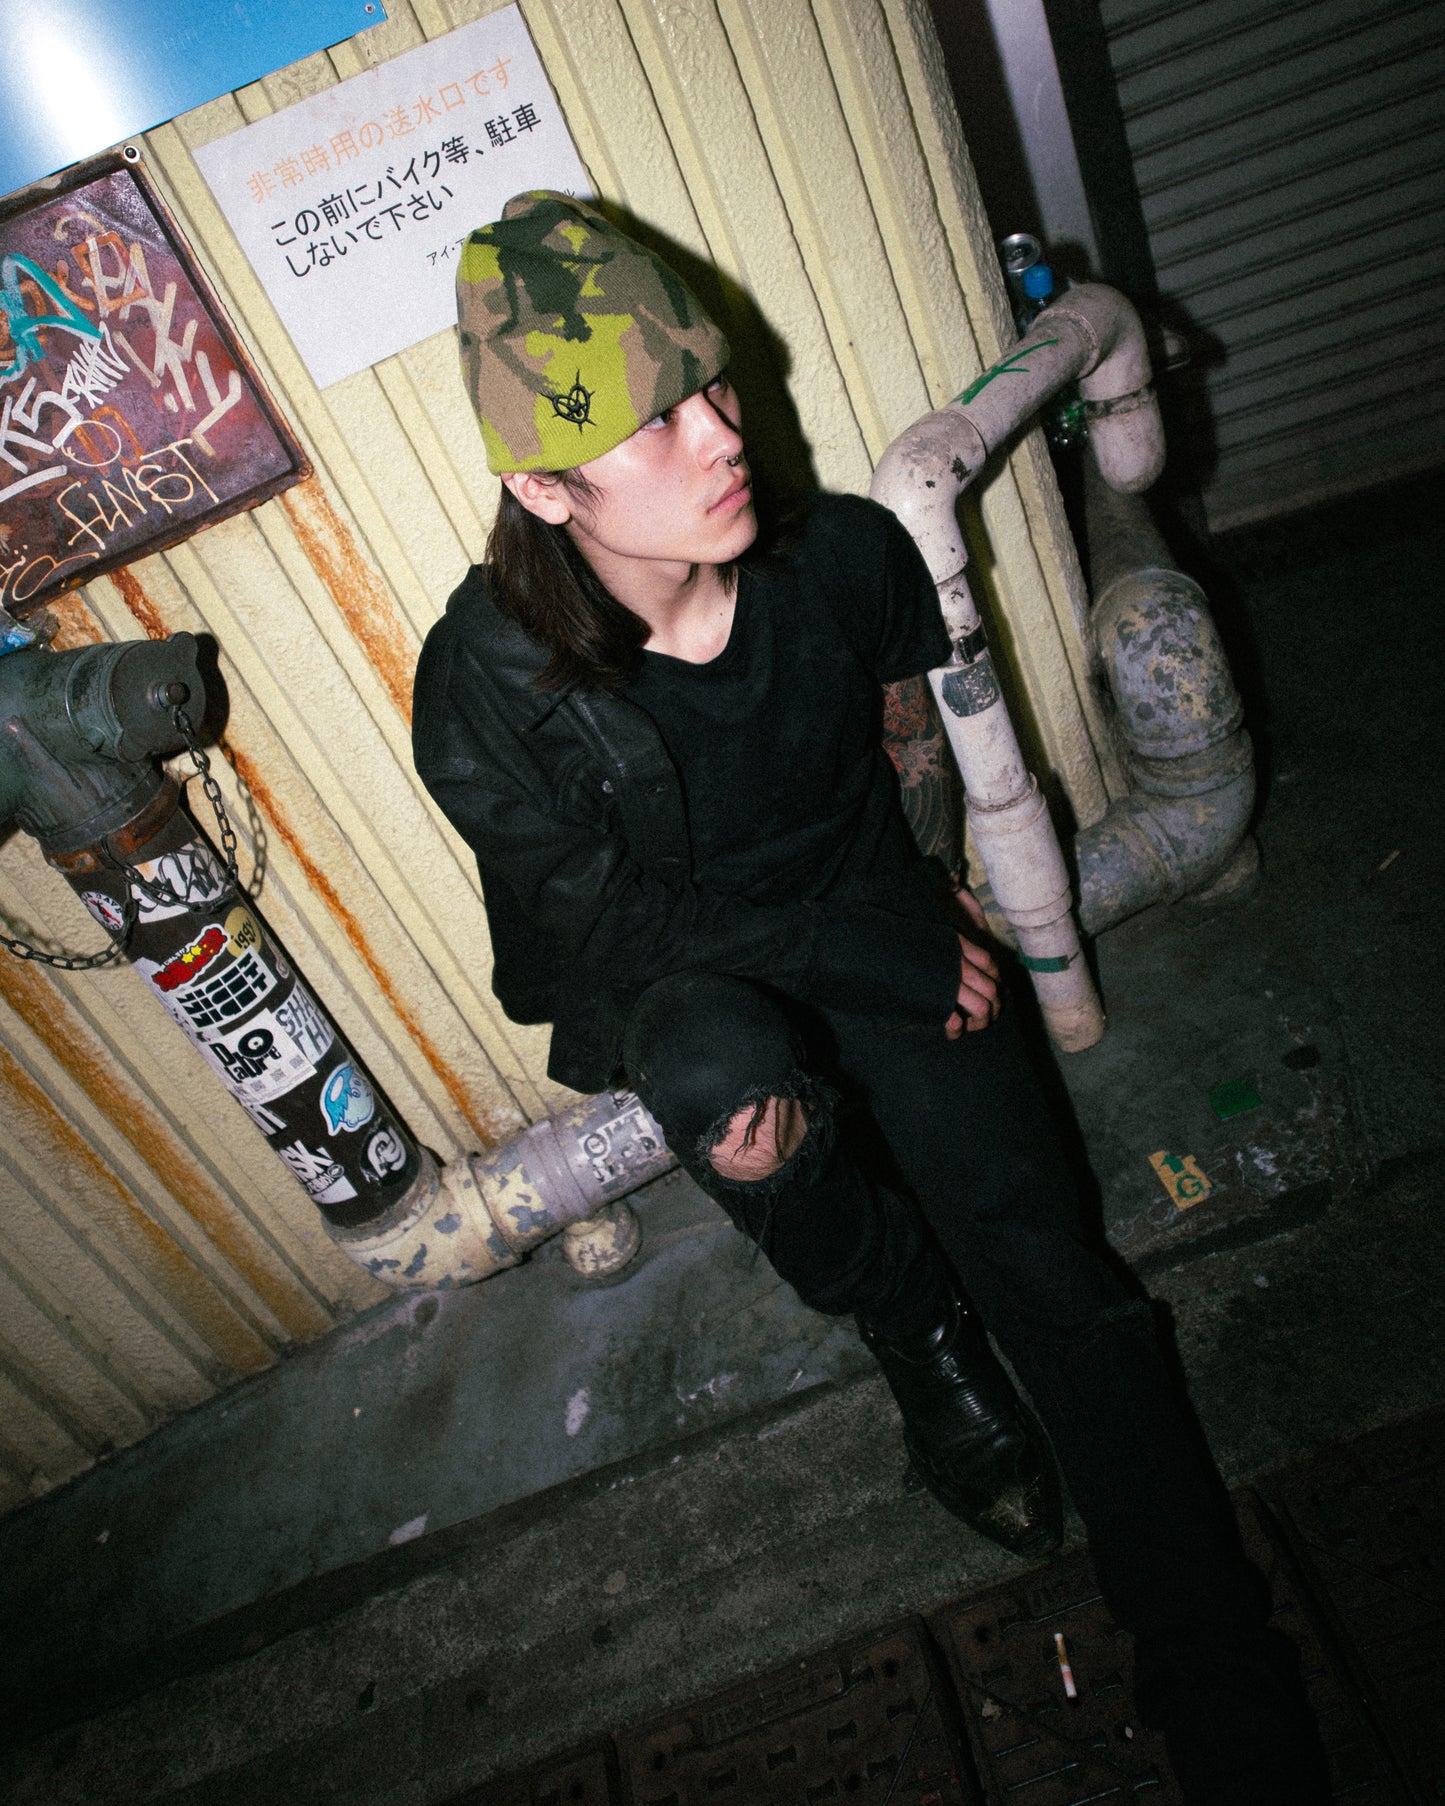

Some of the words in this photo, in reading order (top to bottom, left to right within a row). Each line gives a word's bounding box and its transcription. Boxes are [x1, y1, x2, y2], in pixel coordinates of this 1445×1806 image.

[246, 57, 513, 204] 非常時用の送水口です
[270, 102, 542, 247] この前にバイク等、駐車
[285, 184, 455, 278] しないで下さい
[1176, 1174, 1204, 1198] G
